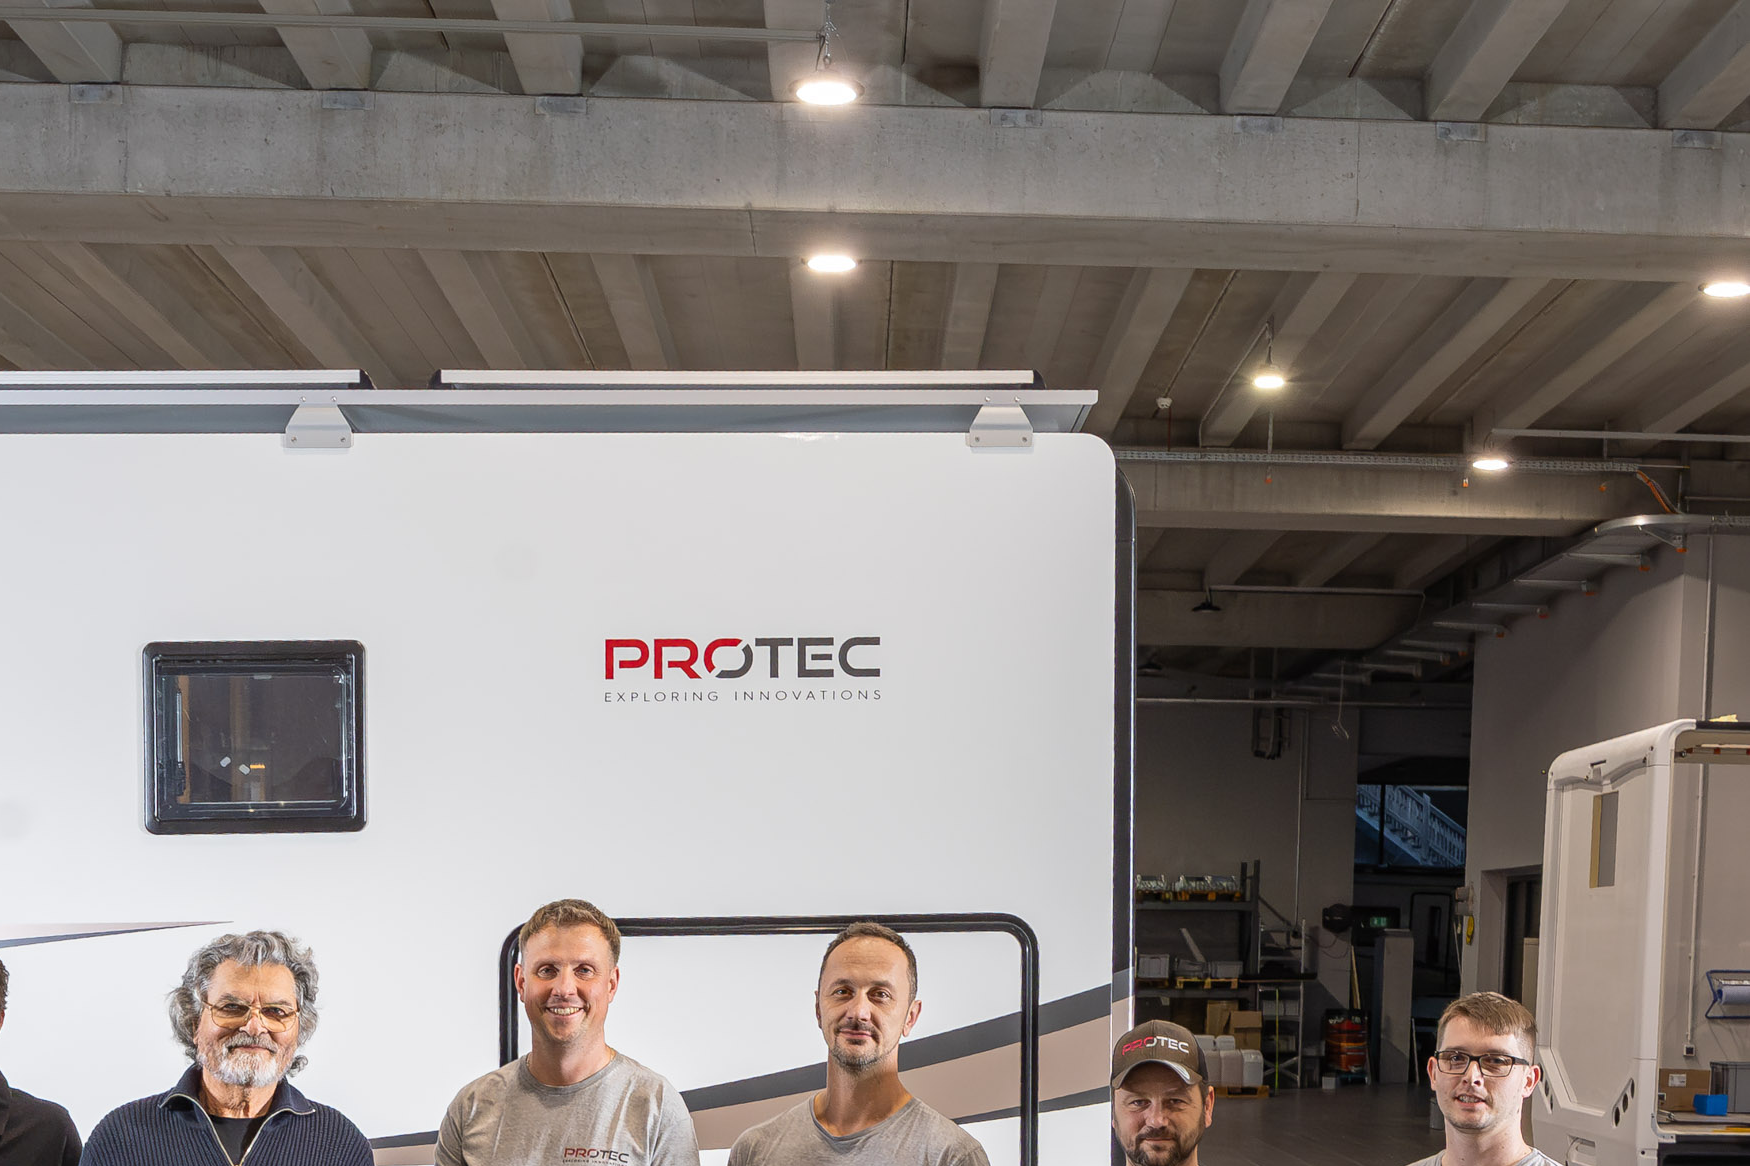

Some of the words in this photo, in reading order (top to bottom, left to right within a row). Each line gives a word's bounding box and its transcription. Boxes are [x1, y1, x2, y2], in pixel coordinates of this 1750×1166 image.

[604, 636, 881, 680] PROTEC
[604, 690, 720, 703] EXPLORING
[733, 688, 882, 702] INNOVATIONS
[1122, 1035, 1190, 1056] PROTEC
[563, 1147, 629, 1164] PROTEC
